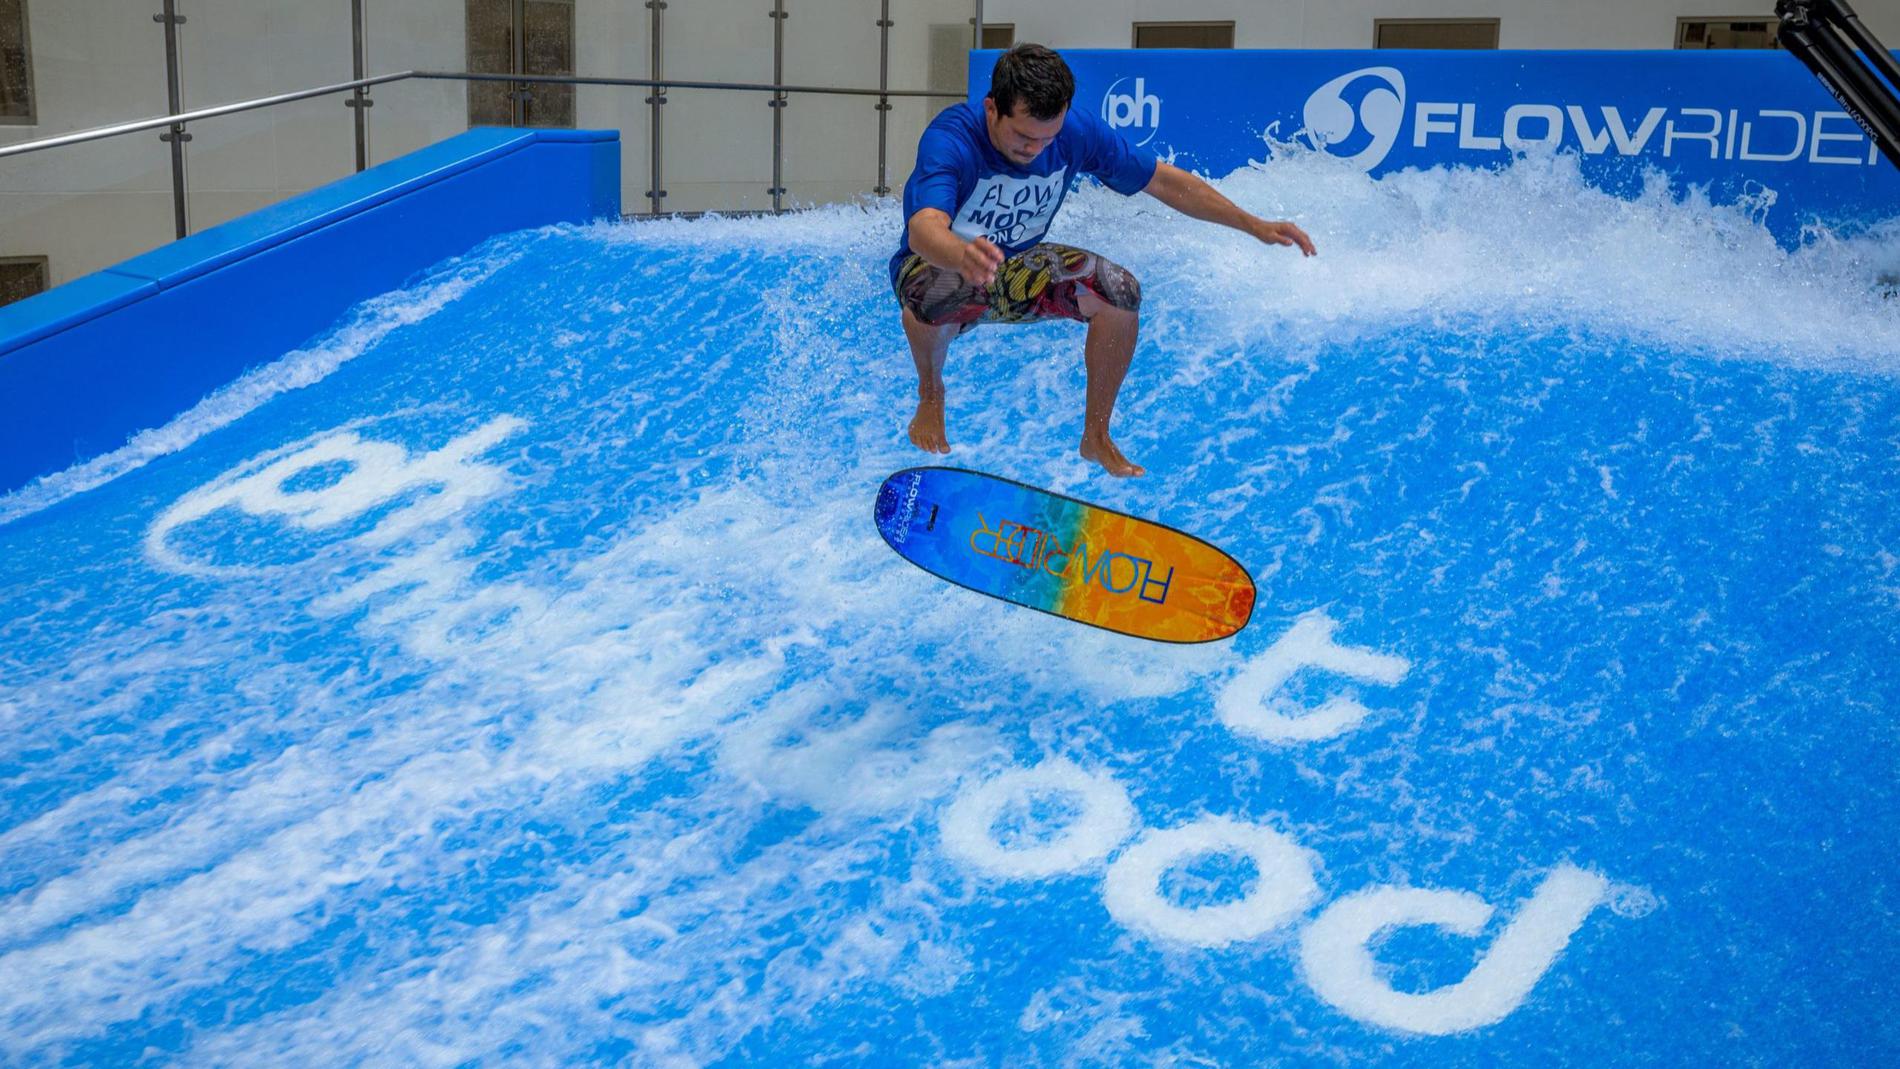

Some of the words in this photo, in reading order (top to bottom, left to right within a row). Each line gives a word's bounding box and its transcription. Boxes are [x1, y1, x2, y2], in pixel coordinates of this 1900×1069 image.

[1106, 76, 1160, 132] ph
[967, 203, 1049, 230] MODE
[979, 180, 1060, 210] FLOW
[899, 472, 922, 544] FLOWRIDER
[969, 511, 1175, 605] FLOWRIDER
